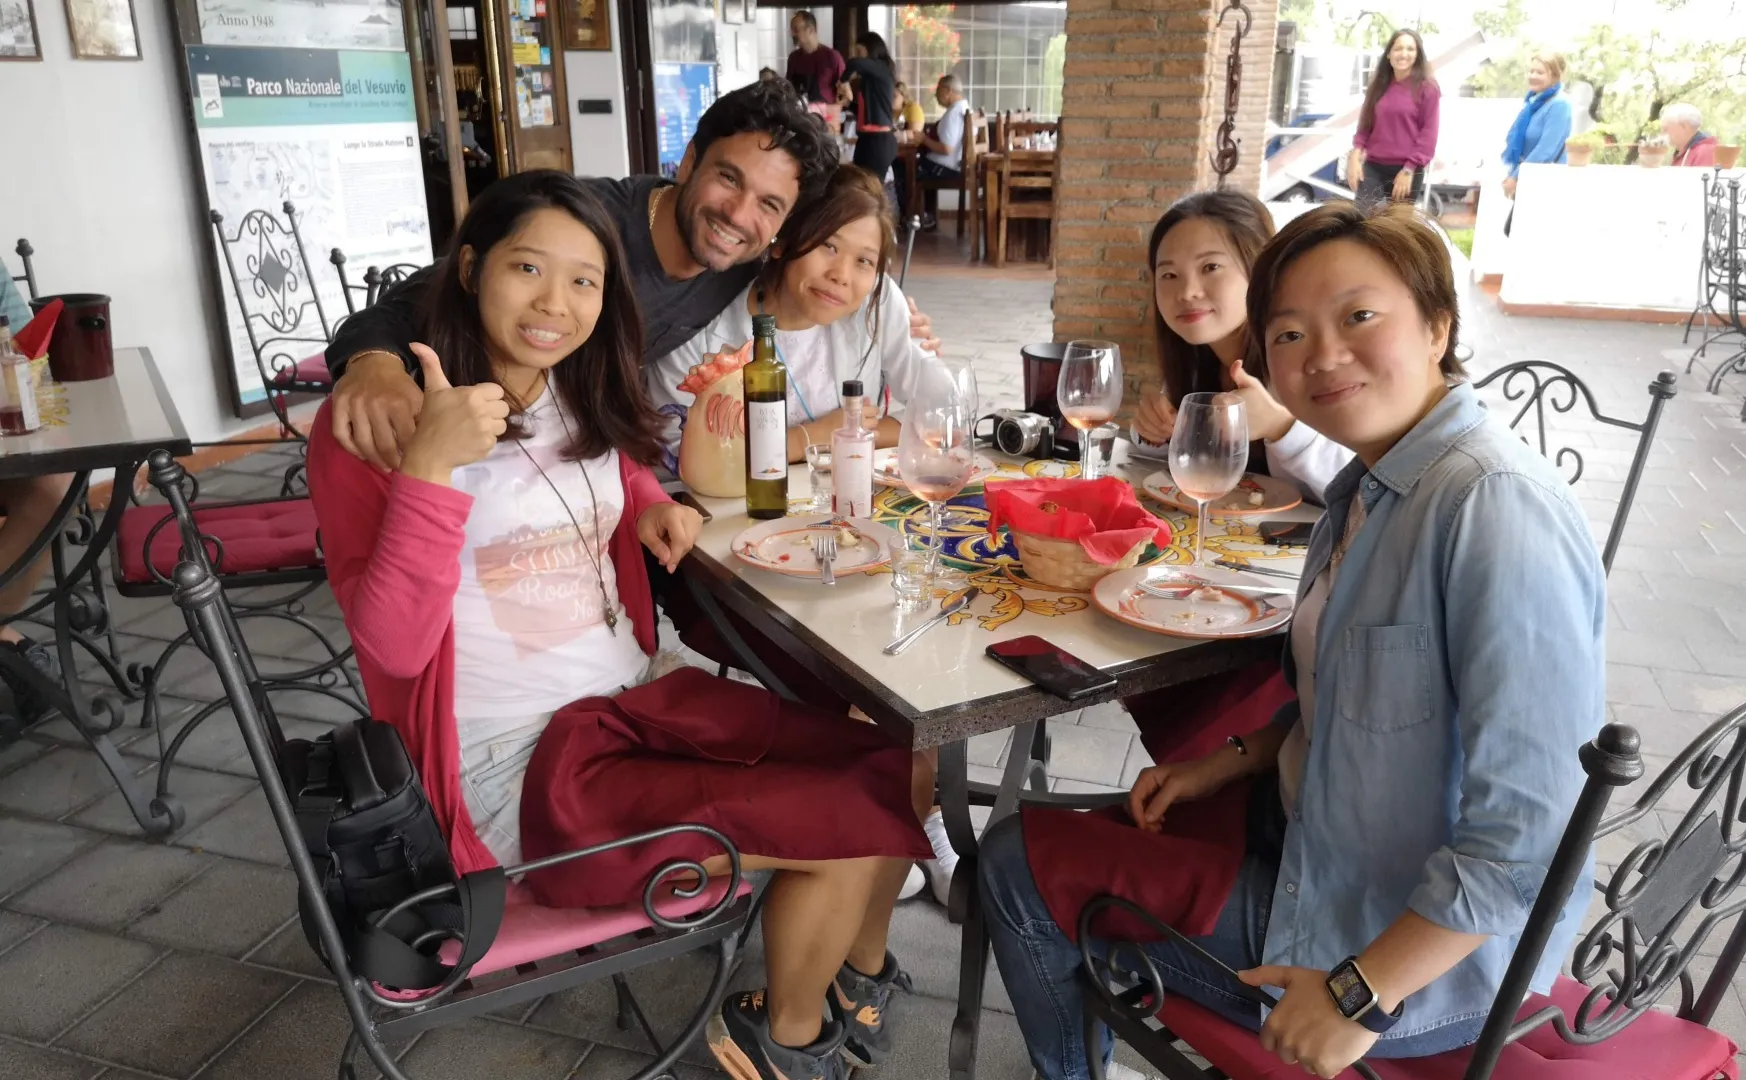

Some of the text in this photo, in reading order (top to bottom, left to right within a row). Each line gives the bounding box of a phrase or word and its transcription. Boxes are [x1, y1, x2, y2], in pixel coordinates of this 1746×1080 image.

[217, 13, 275, 28] Anno 1948
[246, 77, 282, 95] Parco
[285, 77, 341, 95] Nazionale
[345, 79, 362, 94] del
[365, 79, 406, 94] Vesuvio
[517, 577, 583, 605] Road
